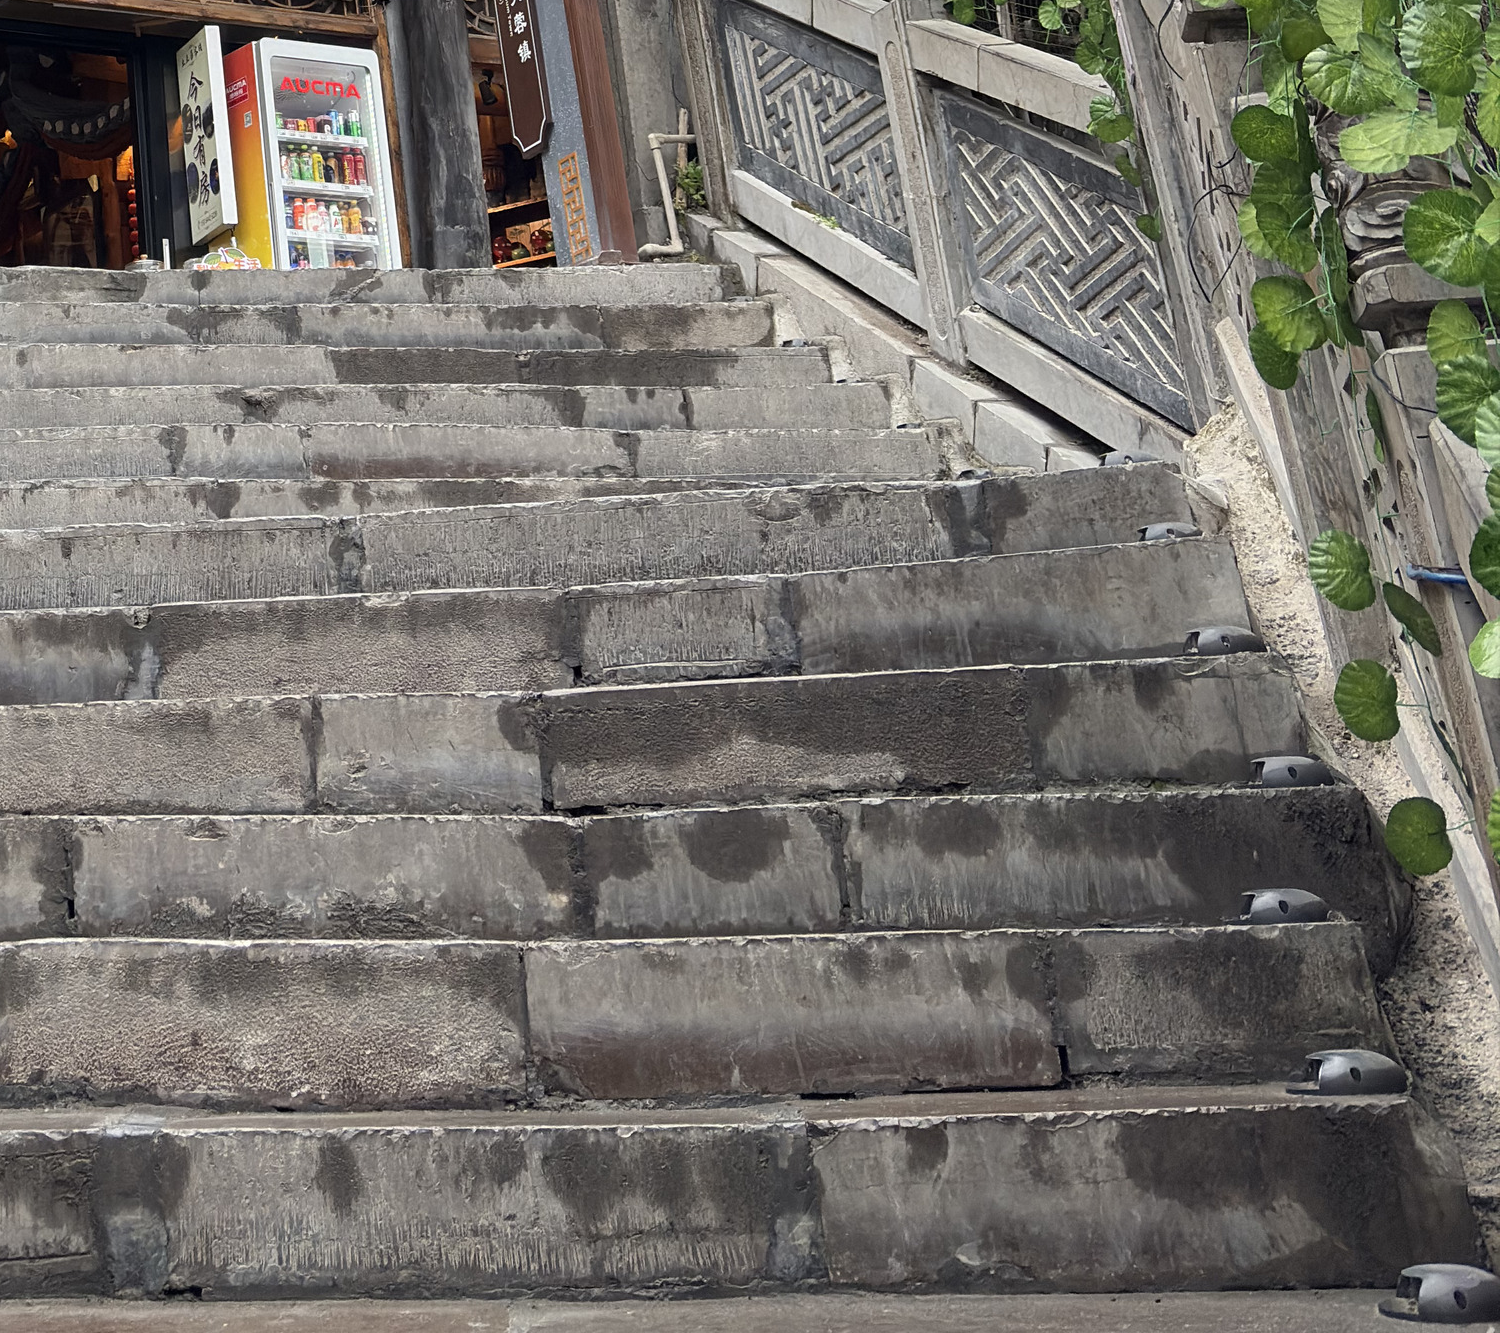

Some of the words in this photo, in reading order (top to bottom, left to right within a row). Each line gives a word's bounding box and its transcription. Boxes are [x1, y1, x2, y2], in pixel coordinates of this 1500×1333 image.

[280, 76, 361, 99] AUCMA
[187, 71, 210, 207] 今日有房
